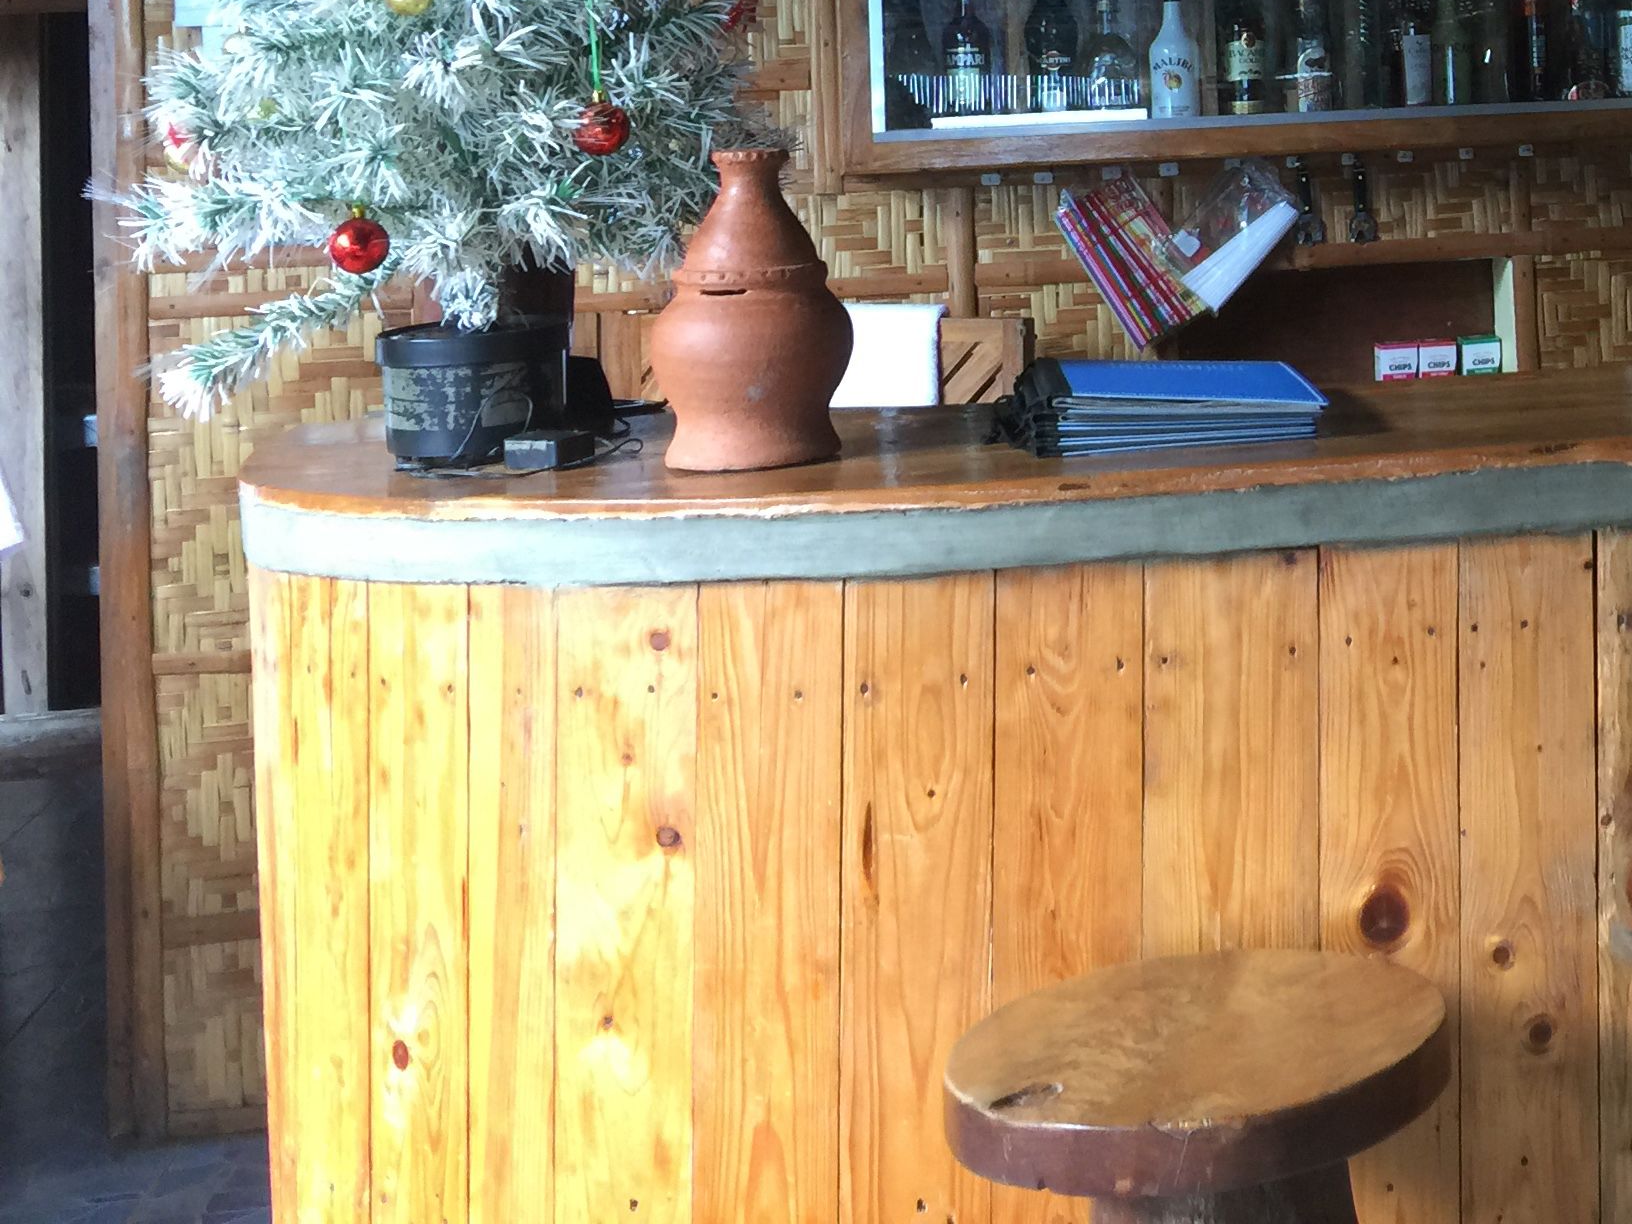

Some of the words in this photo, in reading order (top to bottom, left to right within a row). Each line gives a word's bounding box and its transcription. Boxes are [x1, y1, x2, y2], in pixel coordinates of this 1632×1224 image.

[944, 52, 985, 67] AMPARI
[1427, 360, 1451, 370] CHIPS
[1472, 357, 1495, 366] CHIPS
[1388, 362, 1412, 372] CHIPS
